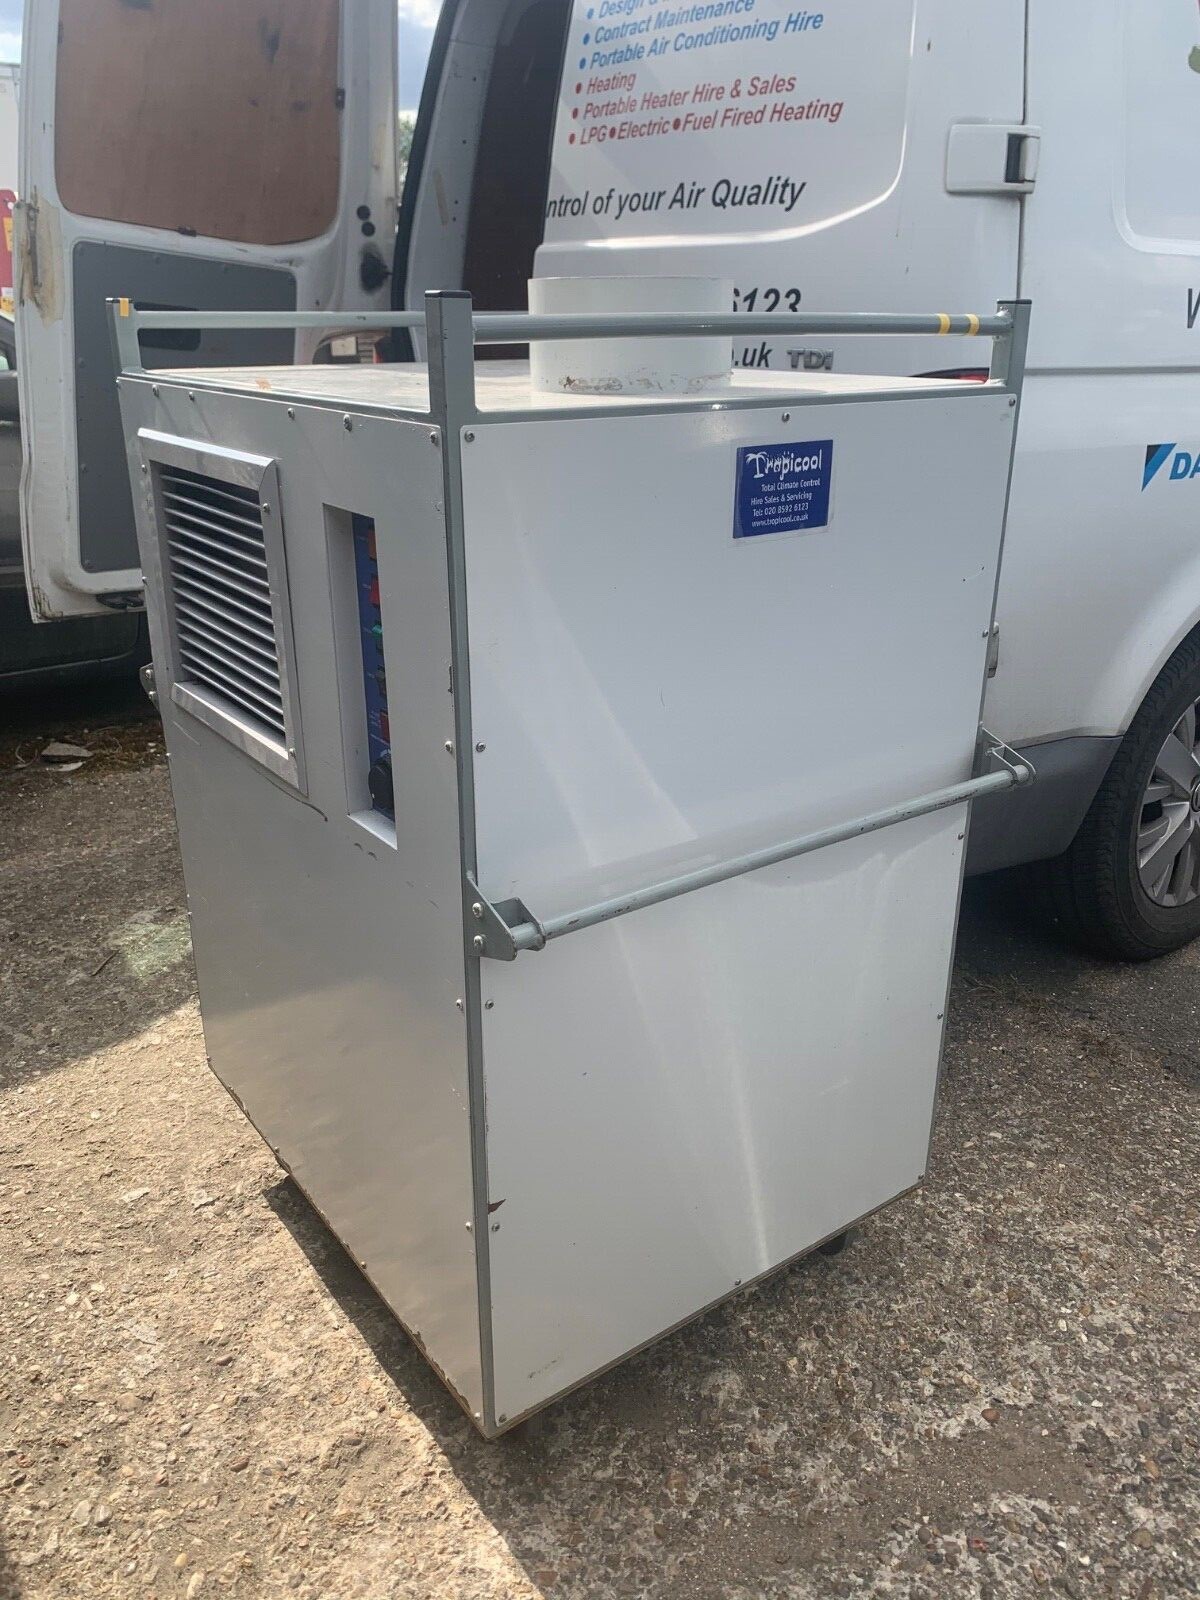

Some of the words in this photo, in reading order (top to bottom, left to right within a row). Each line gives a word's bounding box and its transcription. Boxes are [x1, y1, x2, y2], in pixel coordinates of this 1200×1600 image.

[594, 15, 652, 44] Contract
[654, 0, 756, 30] Maintenance
[589, 43, 645, 69] Portable
[647, 38, 671, 57] Air
[674, 18, 780, 51] Conditioning
[784, 11, 823, 33] Hire
[586, 72, 636, 94] Heating
[583, 96, 637, 119] Portable
[640, 90, 689, 110] Heater
[691, 83, 725, 103] Hire
[730, 78, 741, 98] &
[747, 74, 797, 96] Sales
[580, 125, 608, 145] LPG
[616, 117, 671, 140] Electric
[682, 109, 718, 132] Fuel
[720, 104, 767, 127] Fired
[769, 99, 844, 123] Heating
[592, 188, 615, 214] of
[615, 189, 666, 220] your
[668, 181, 706, 210] Air
[712, 176, 807, 212] Quality
[787, 349, 834, 370] TDI
[745, 449, 822, 480] Tropicool
[761, 483, 775, 492] Total
[777, 481, 799, 490] Climate
[800, 478, 820, 487] Control
[751, 497, 763, 506] Hire
[764, 495, 779, 504] Sales
[781, 494, 785, 502] &
[786, 491, 812, 501] Servicing
[753, 508, 763, 517] Tel:
[764, 507, 776, 516] 020
[778, 505, 793, 513] 8592
[794, 502, 808, 511] 6123
[752, 513, 808, 527] www.tropicool.co.uk
